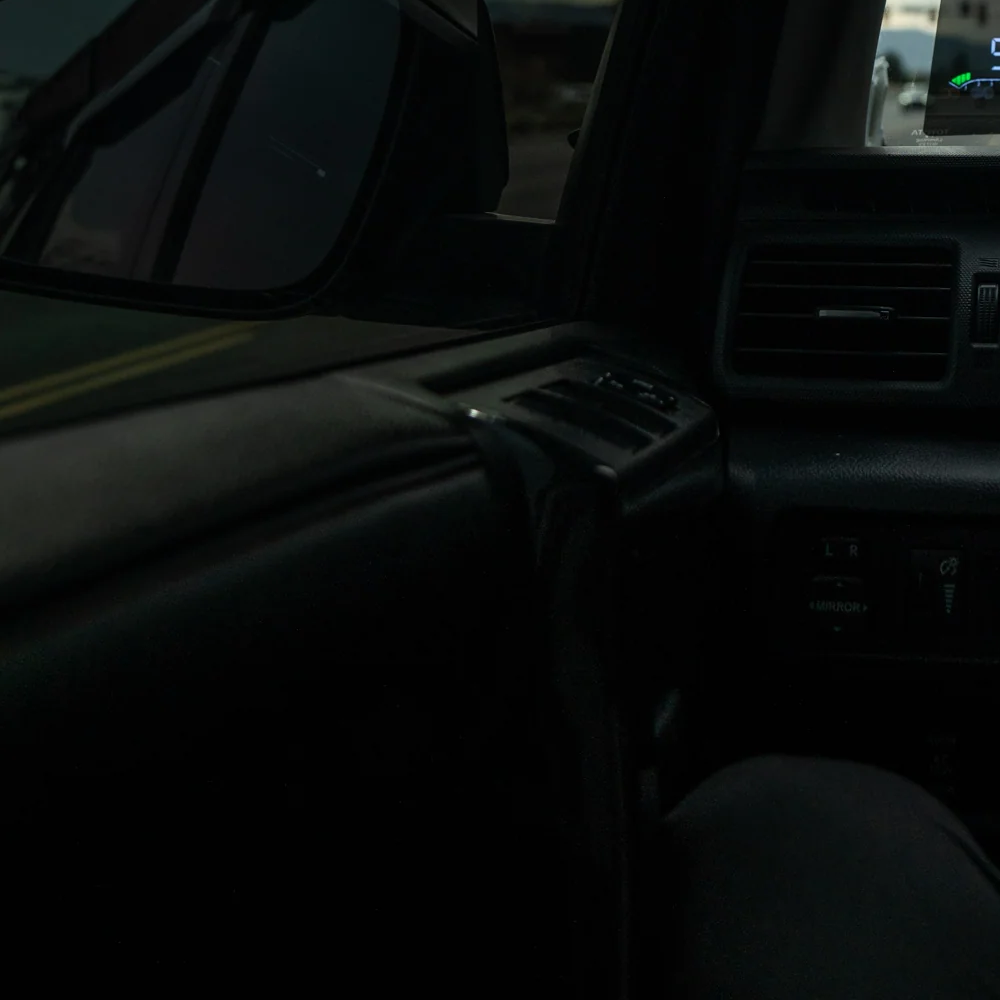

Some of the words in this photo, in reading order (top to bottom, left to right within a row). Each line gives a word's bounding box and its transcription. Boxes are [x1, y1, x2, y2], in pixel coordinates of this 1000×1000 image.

[824, 541, 834, 557] L
[849, 543, 859, 558] R
[816, 600, 861, 613] MIRROR
